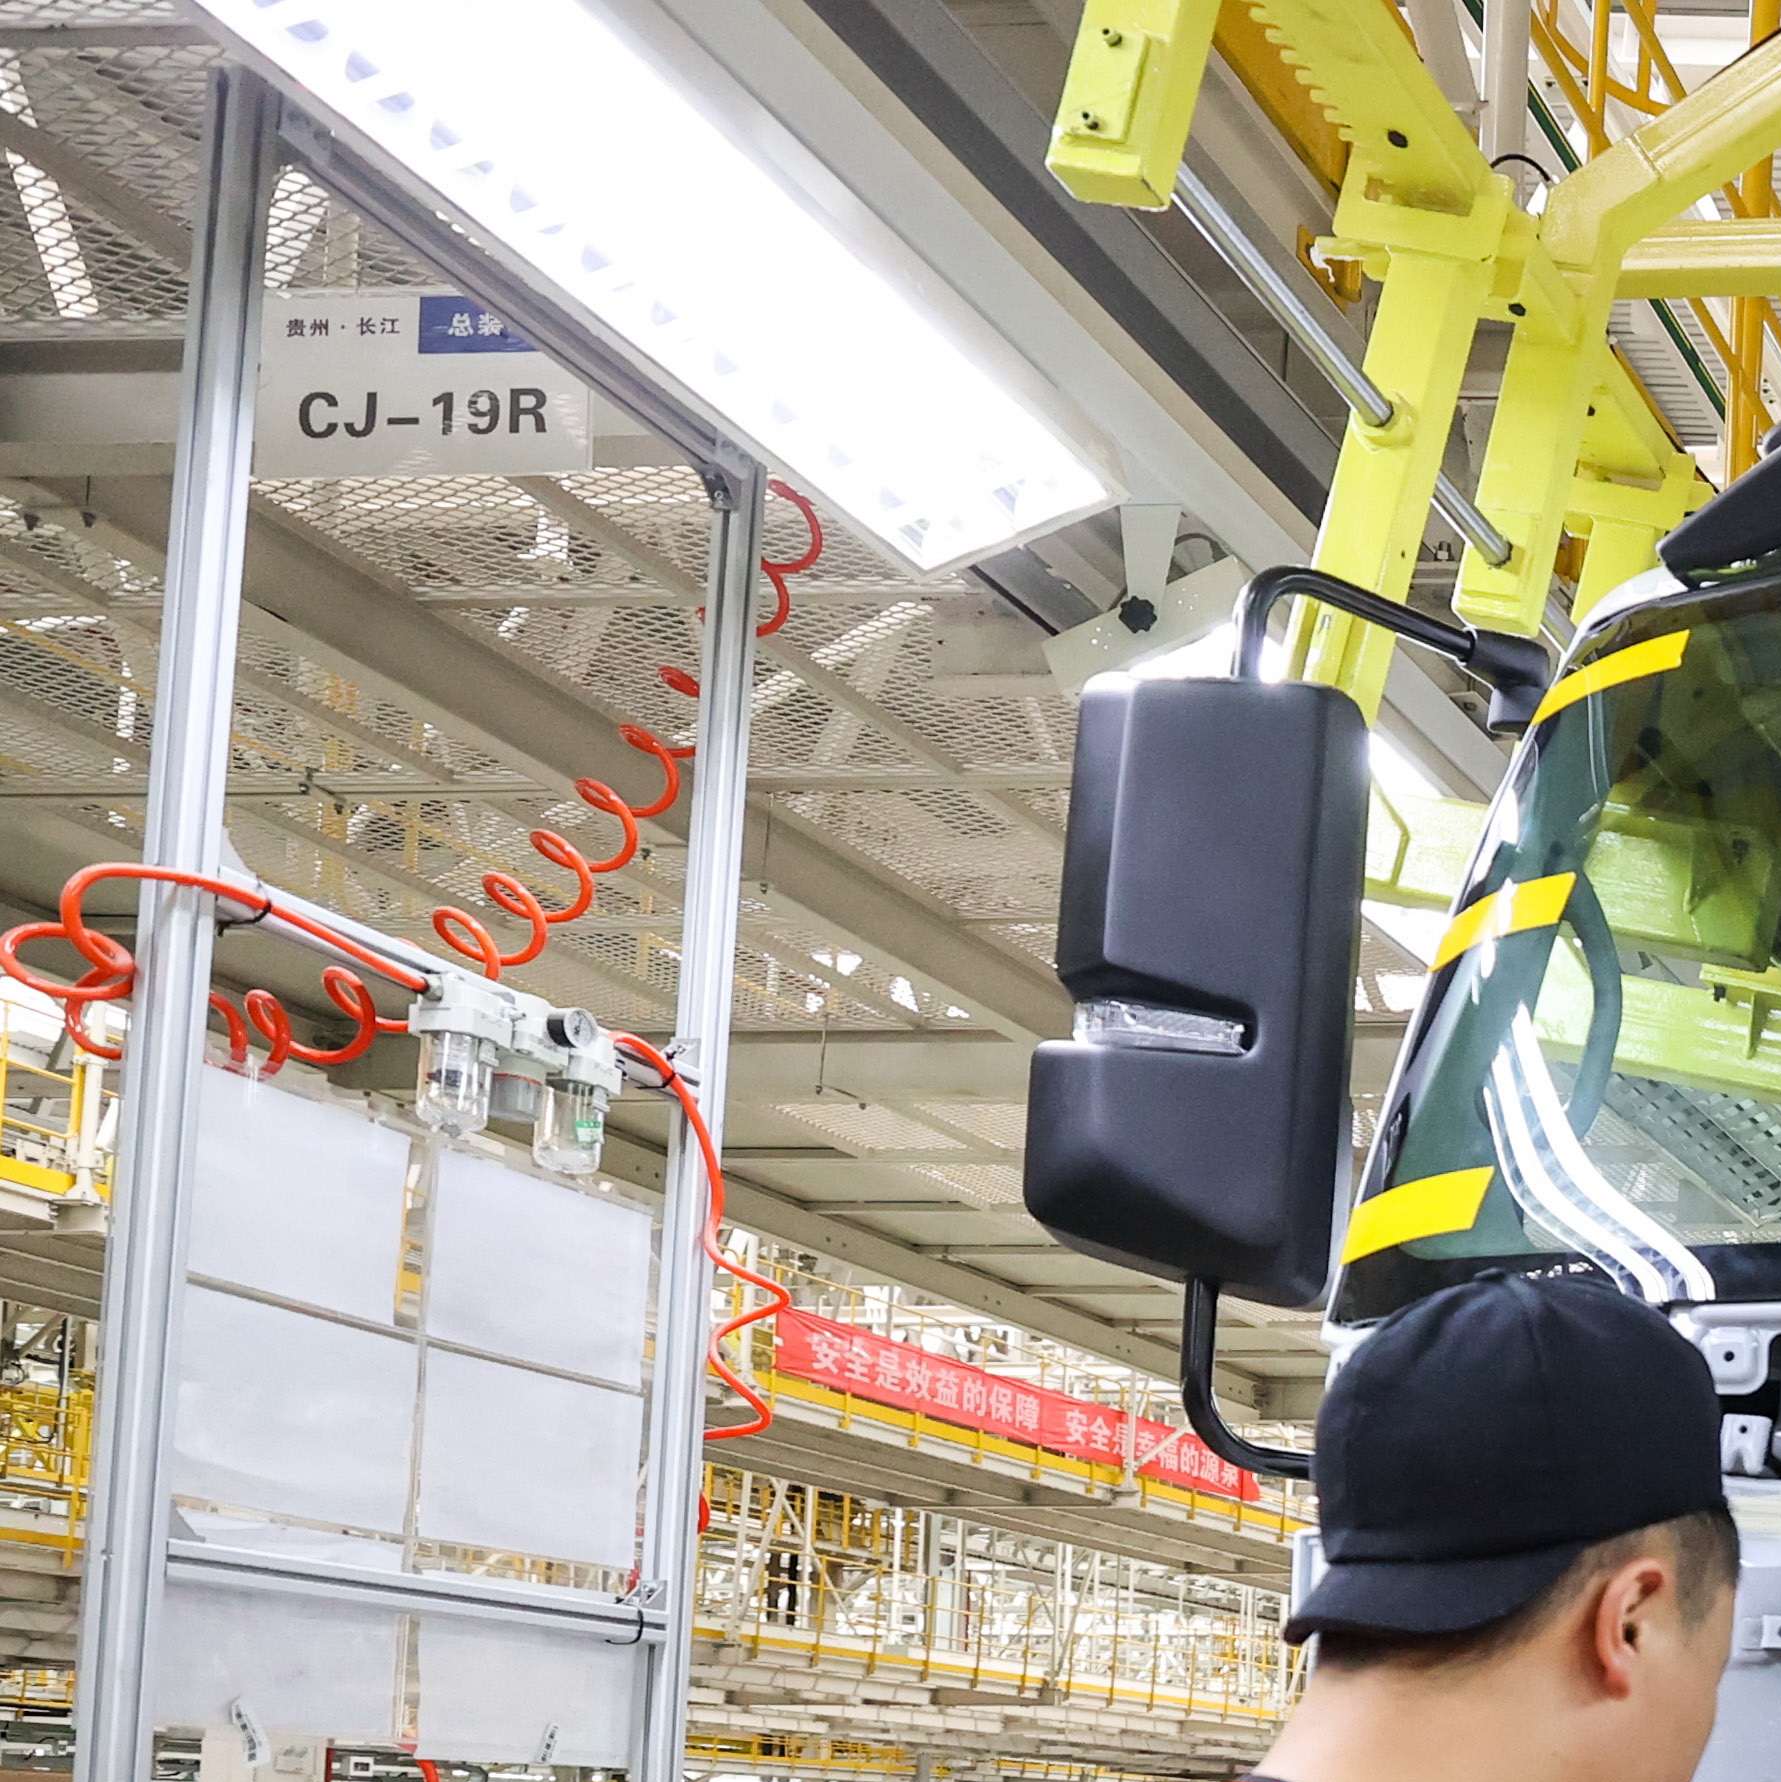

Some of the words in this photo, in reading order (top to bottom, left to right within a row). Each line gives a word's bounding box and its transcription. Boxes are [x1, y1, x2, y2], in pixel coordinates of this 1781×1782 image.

[299, 388, 547, 438] CJ-19R
[806, 1329, 1041, 1432] 安全是效益的保障
